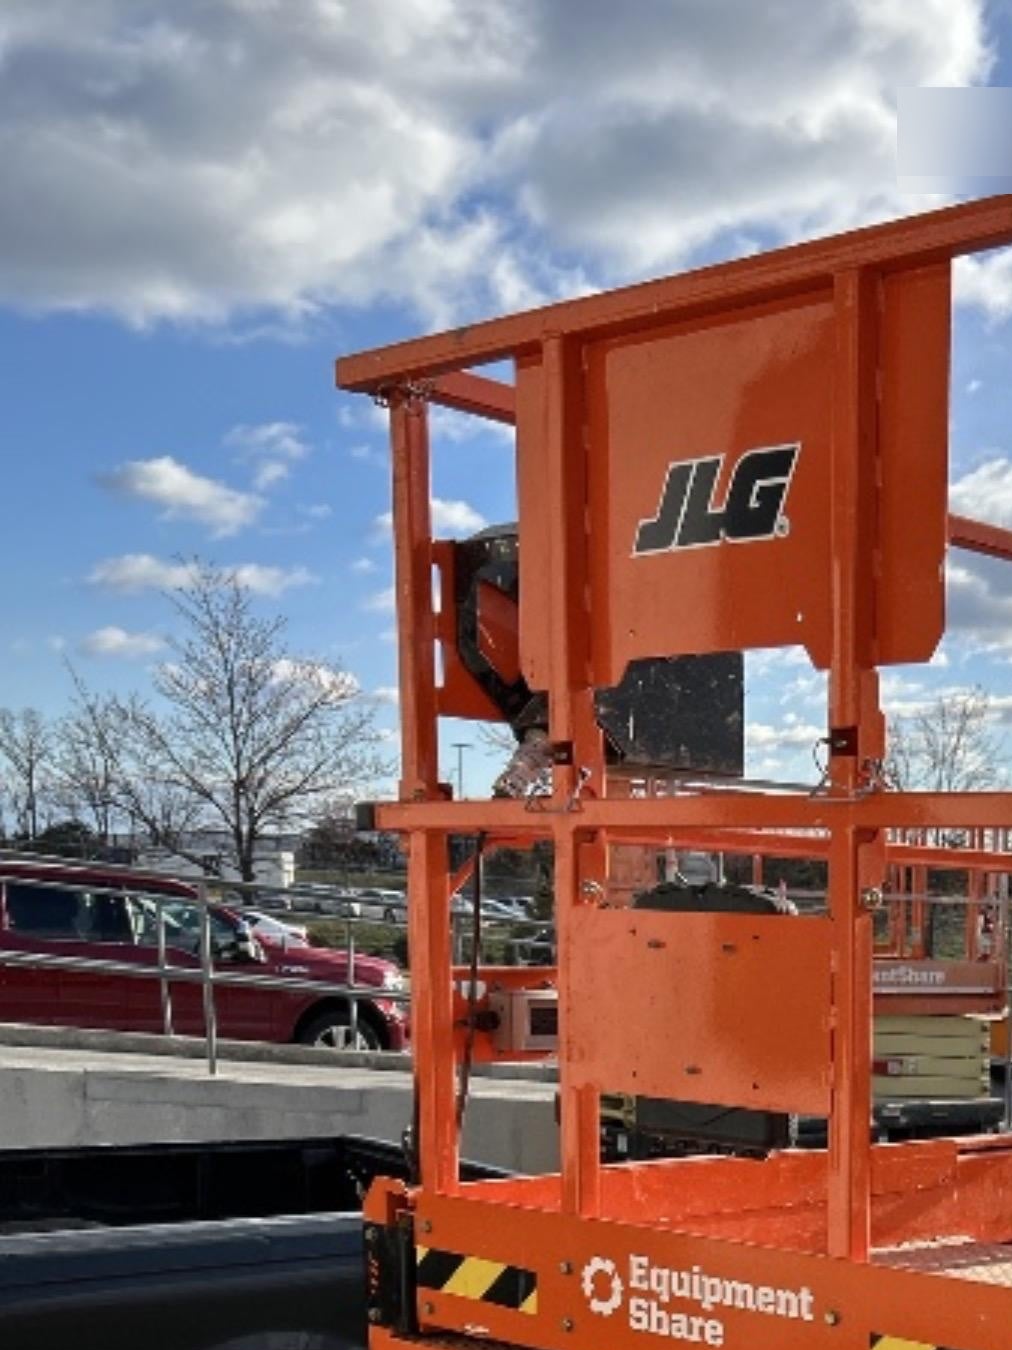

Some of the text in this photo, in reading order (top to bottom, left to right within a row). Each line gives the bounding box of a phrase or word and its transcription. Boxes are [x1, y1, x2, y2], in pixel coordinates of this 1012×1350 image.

[631, 441, 801, 557] JLG
[628, 1253, 815, 1322] Equipment
[628, 1296, 725, 1348] Share
